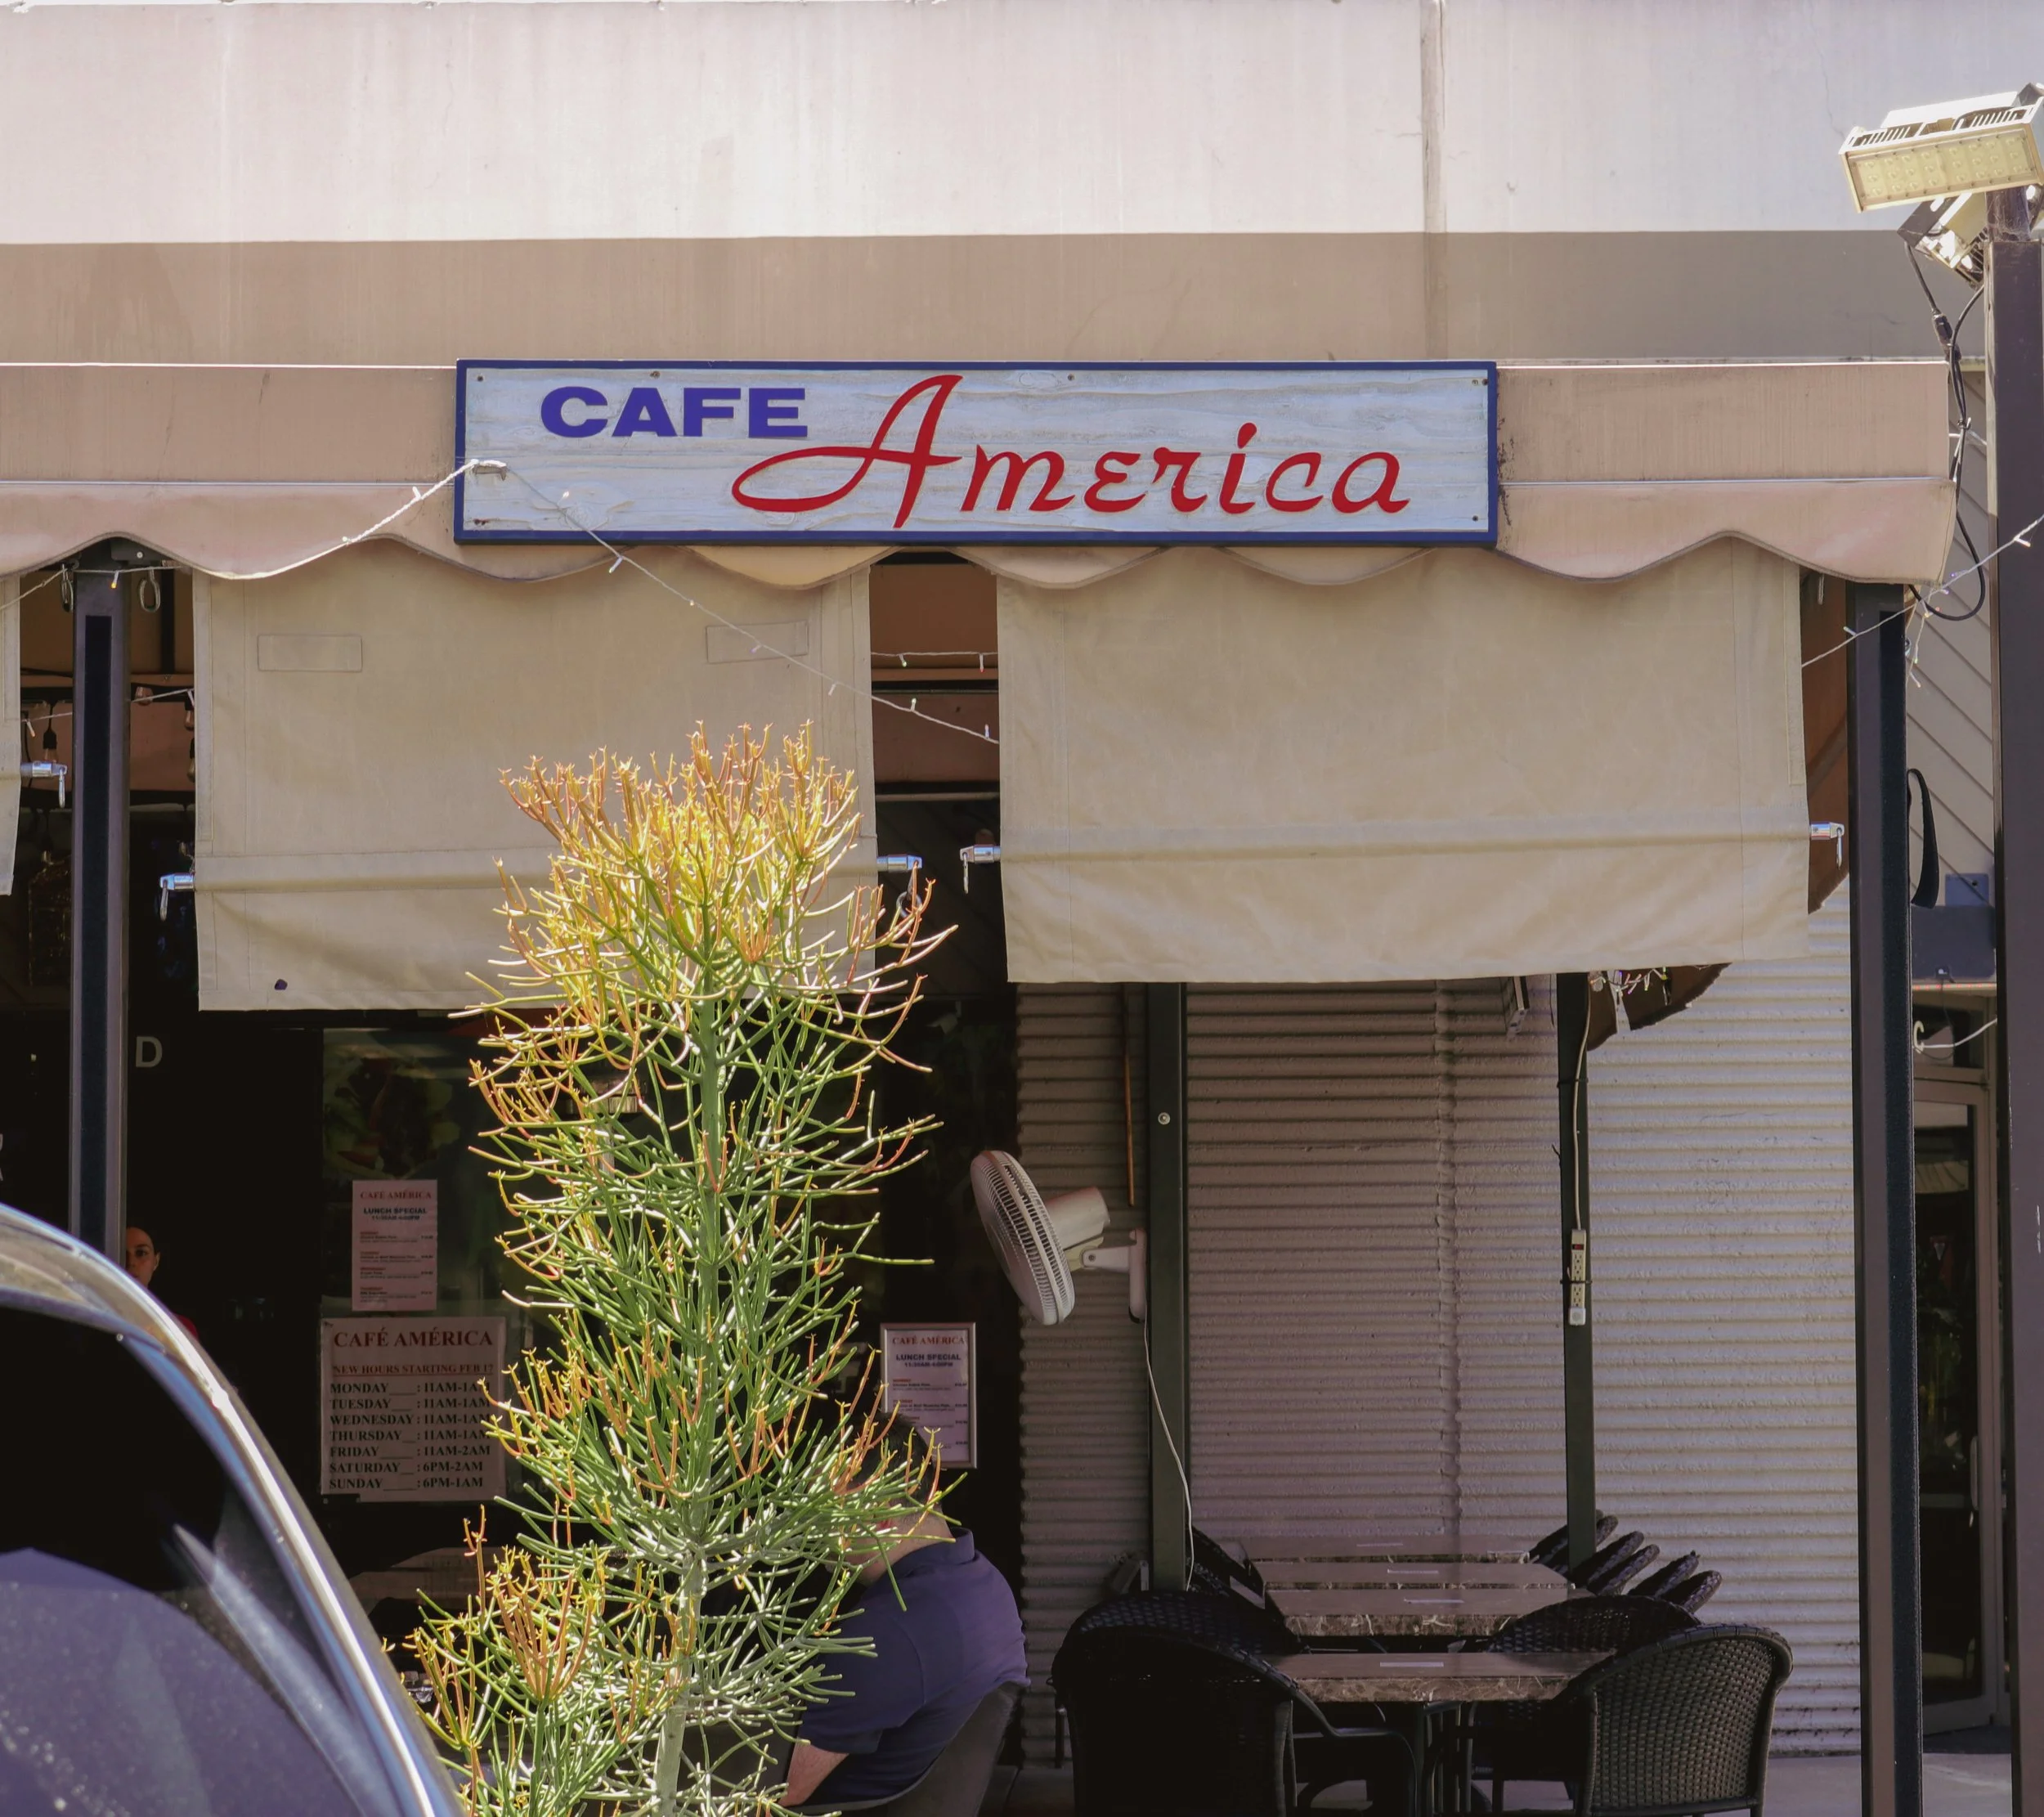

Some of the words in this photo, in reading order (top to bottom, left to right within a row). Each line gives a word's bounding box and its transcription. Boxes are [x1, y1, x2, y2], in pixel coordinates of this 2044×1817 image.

[540, 386, 808, 438] CAFE
[730, 374, 1411, 528] America
[135, 1035, 163, 1068] D
[334, 1327, 388, 1347] CAFÉ
[394, 1326, 493, 1346] AMÉRICA
[892, 1335, 917, 1345] CAFÉ
[333, 1365, 358, 1374] NEW
[361, 1365, 400, 1374] HOURS
[402, 1364, 458, 1374] STARTING
[330, 1383, 389, 1393] MONDAY
[329, 1398, 392, 1410] TUESDAY
[329, 1415, 414, 1425] WEDNESDAY
[329, 1430, 402, 1442] THURSDAY
[329, 1447, 379, 1457] FRIDAY
[424, 1446, 491, 1456] 11AM-2AM
[329, 1462, 401, 1473] SATURDAY
[423, 1461, 483, 1471] 6PM-2AM
[329, 1478, 383, 1489] SUNDAY
[423, 1478, 483, 1488] 6PM-1AM
